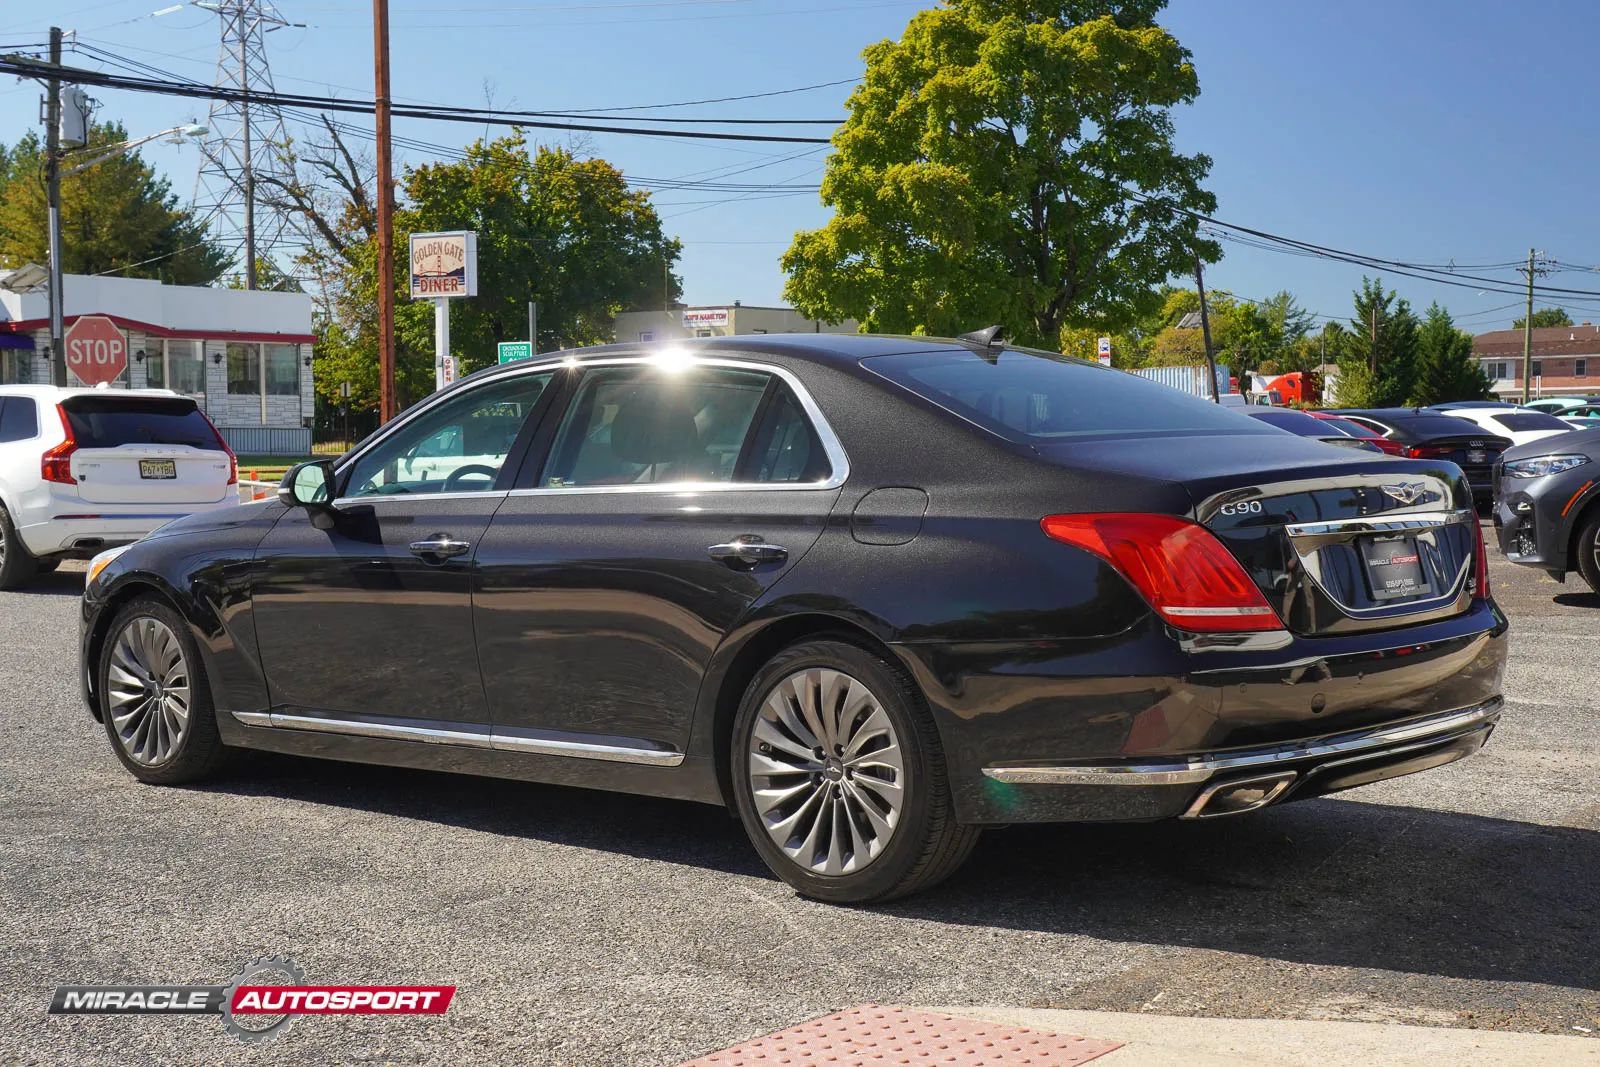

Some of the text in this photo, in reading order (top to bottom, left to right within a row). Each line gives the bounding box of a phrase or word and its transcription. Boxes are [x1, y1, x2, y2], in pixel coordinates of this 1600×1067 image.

[413, 241, 464, 264] GOLDEN GATE
[420, 278, 458, 292] DINER
[70, 339, 122, 364] STOP
[1220, 500, 1262, 516] G90
